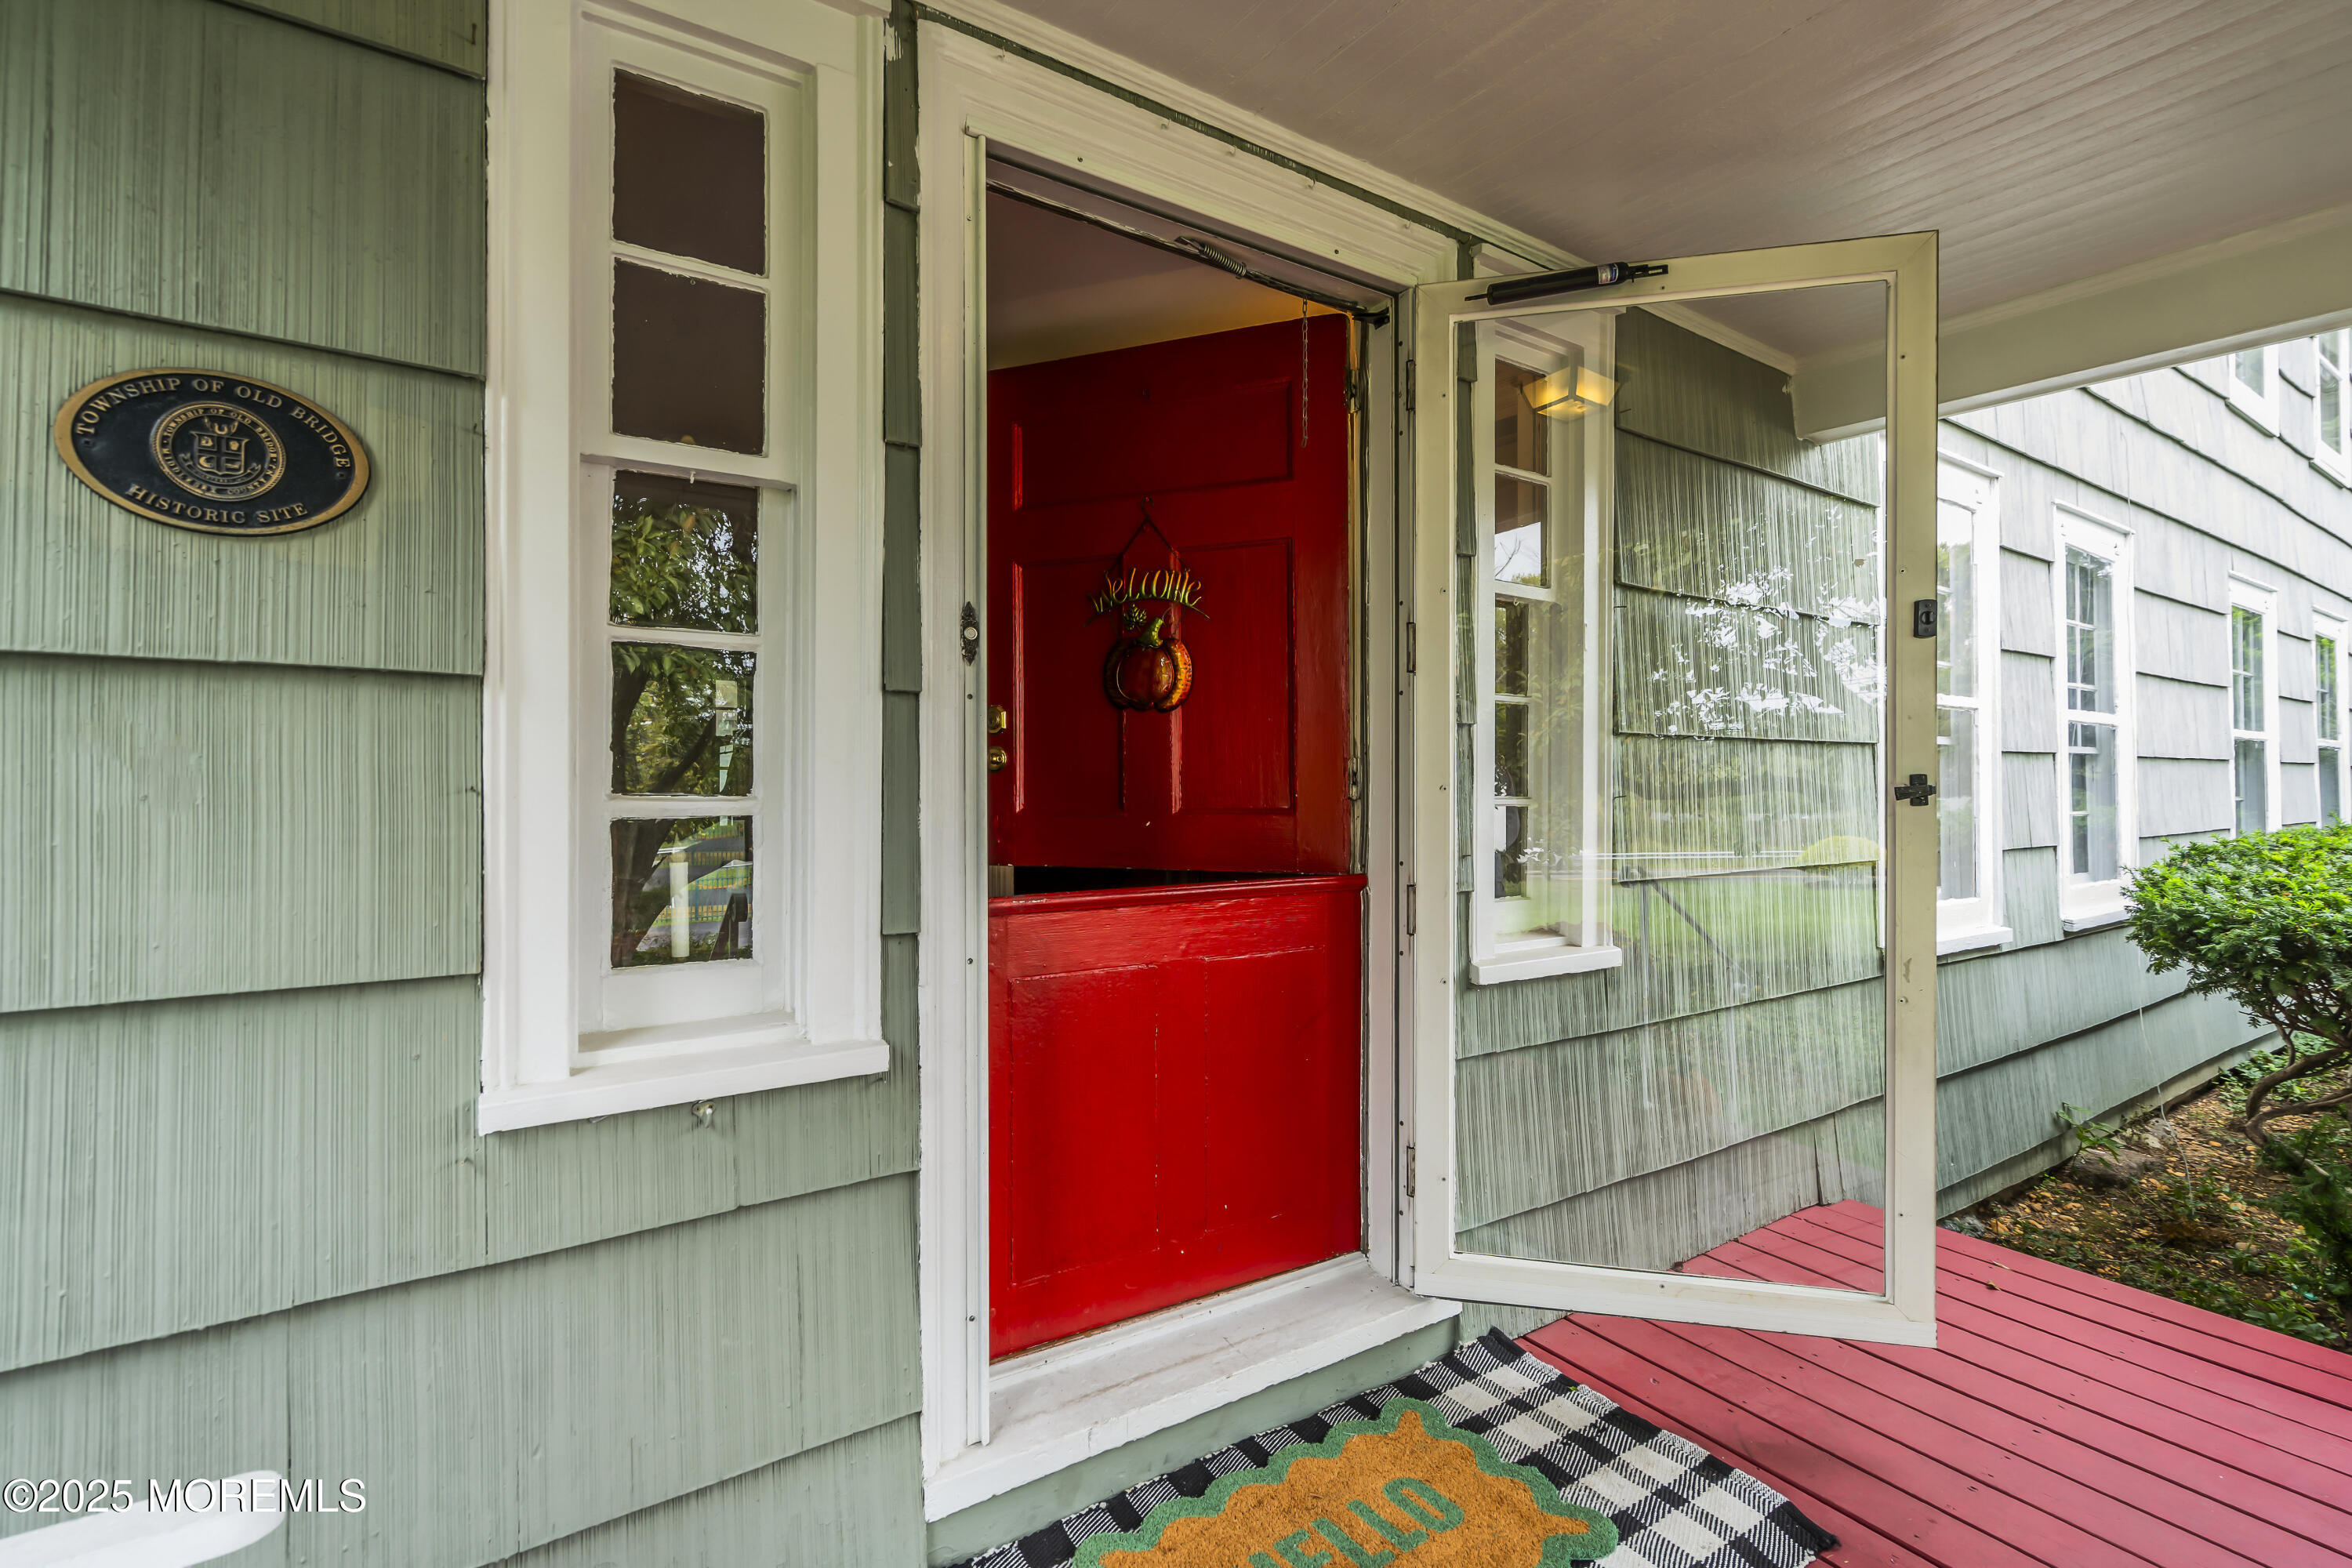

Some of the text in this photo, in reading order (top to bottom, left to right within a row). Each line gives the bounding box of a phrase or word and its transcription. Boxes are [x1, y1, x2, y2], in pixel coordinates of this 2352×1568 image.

[76, 378, 351, 468] TOWNSHIP OF OLD BRIDGE
[162, 408, 204, 437] TOWNSHIP
[230, 412, 251, 424] OLD
[128, 484, 308, 524] HISTORIC SITE
[1247, 1477, 1465, 1568] ELLO
